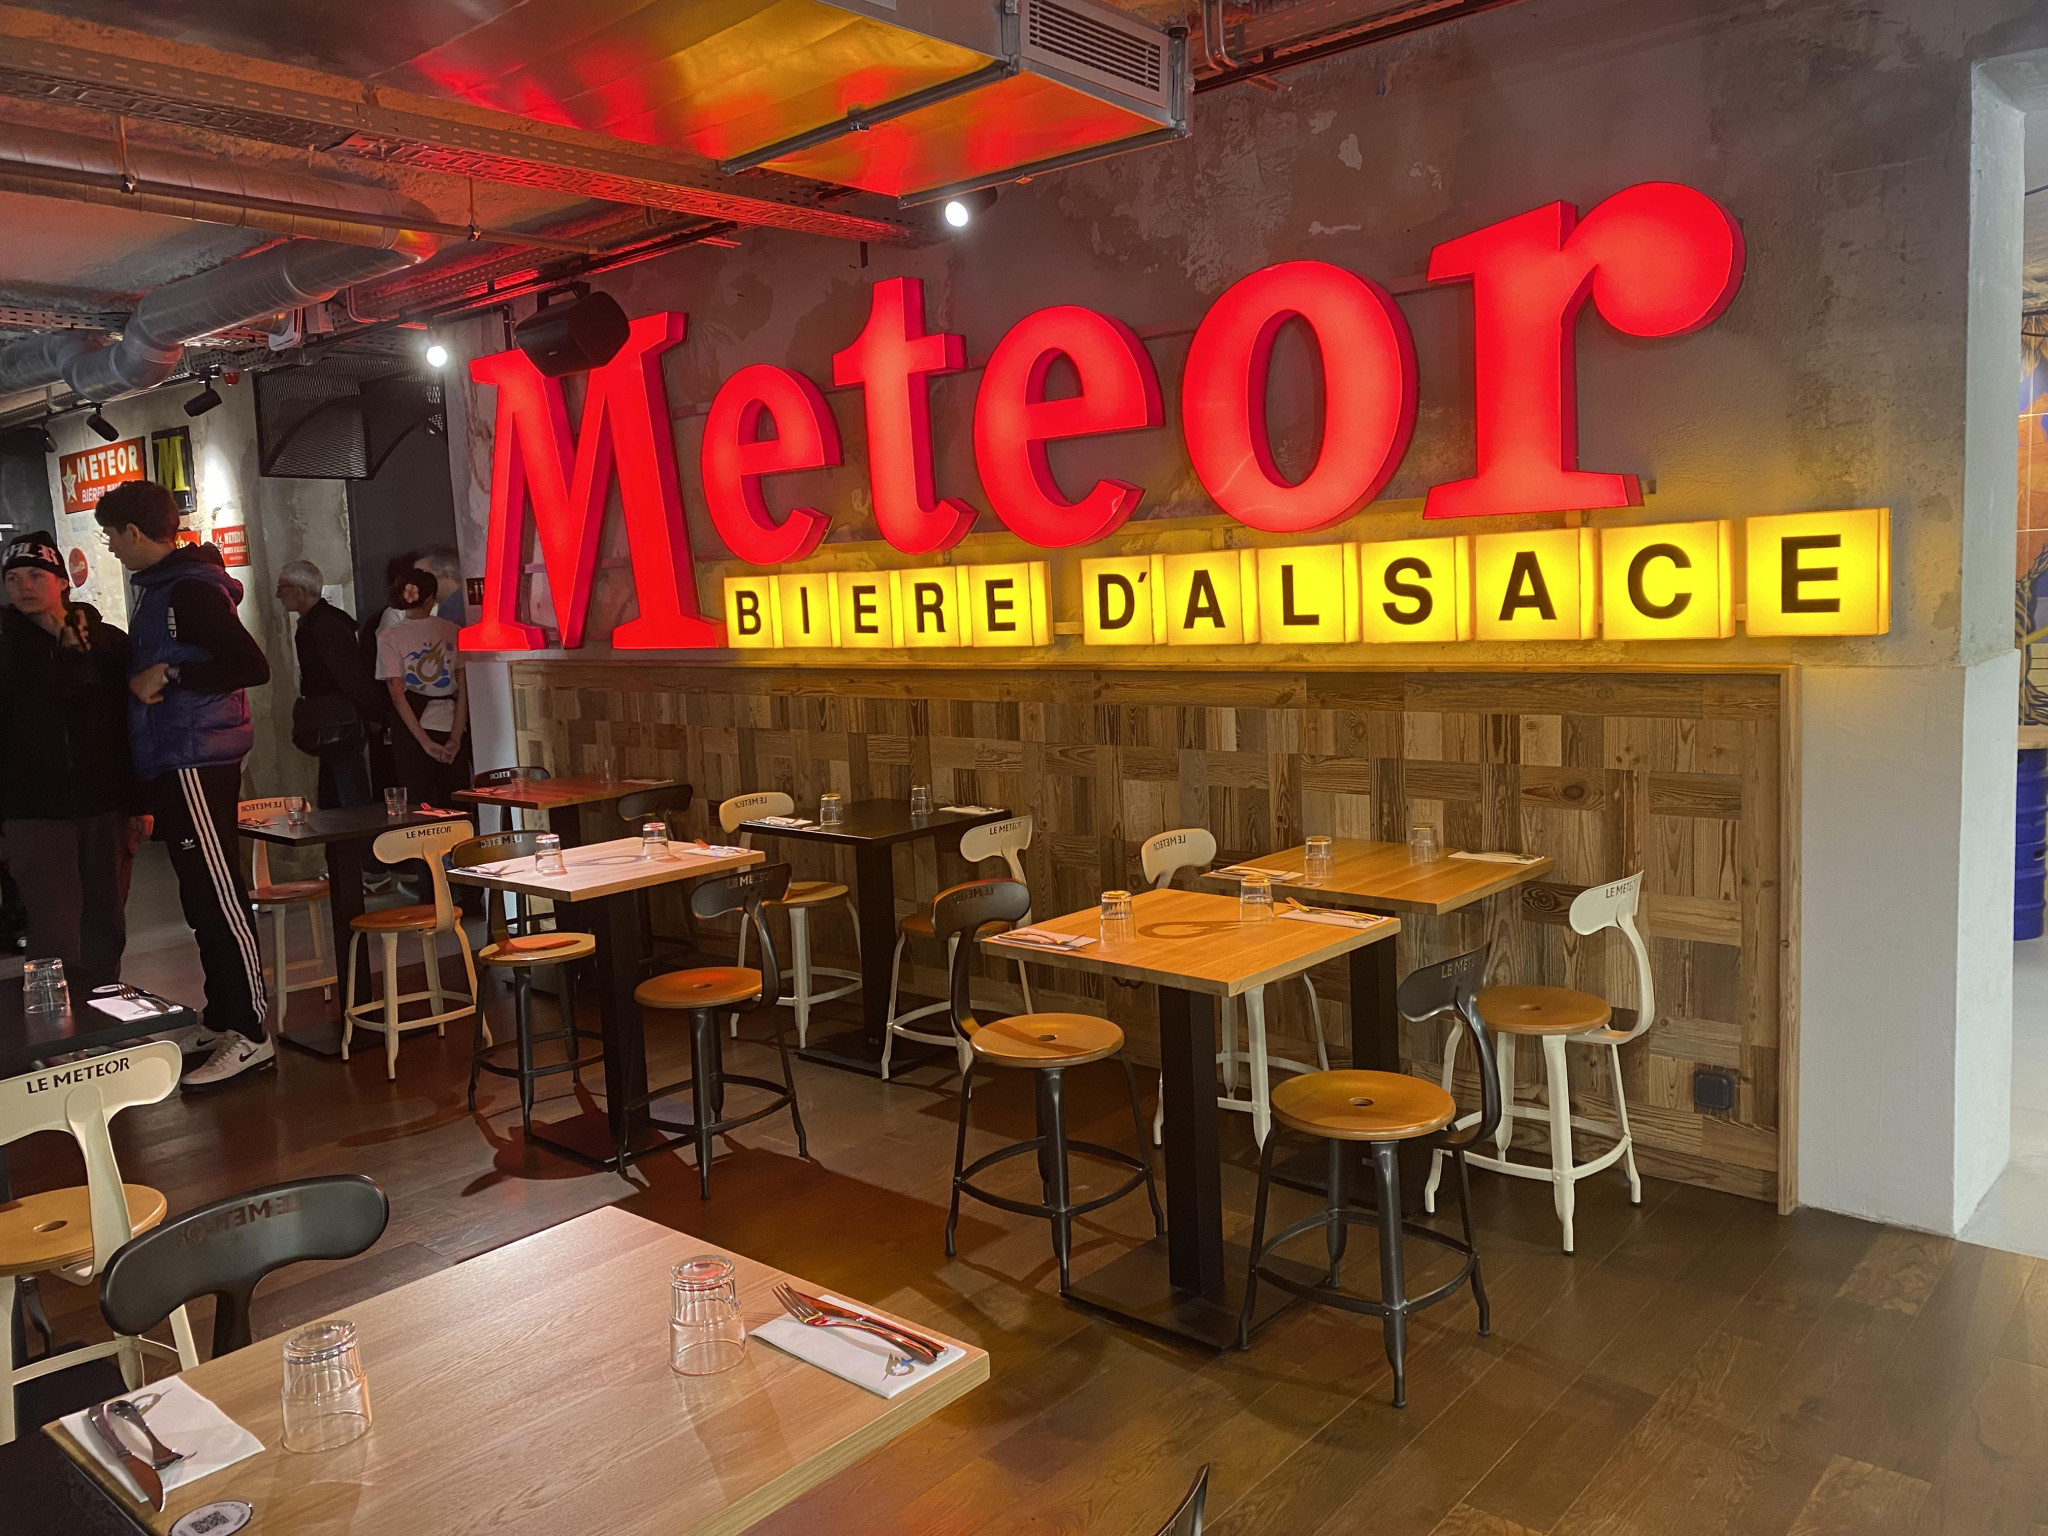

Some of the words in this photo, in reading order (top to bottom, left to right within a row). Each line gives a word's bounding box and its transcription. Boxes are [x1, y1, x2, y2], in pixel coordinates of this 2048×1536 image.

[458, 181, 1746, 650] Meteor
[76, 444, 139, 483] METEOR
[735, 578, 1017, 636] BIERE
[405, 830, 417, 840] LE
[417, 825, 452, 838] METEOR
[989, 826, 998, 836] LE
[1605, 886, 1615, 899] LE
[1441, 962, 1453, 979] LE
[26, 1077, 49, 1094] LE
[53, 1057, 130, 1088] METEOR
